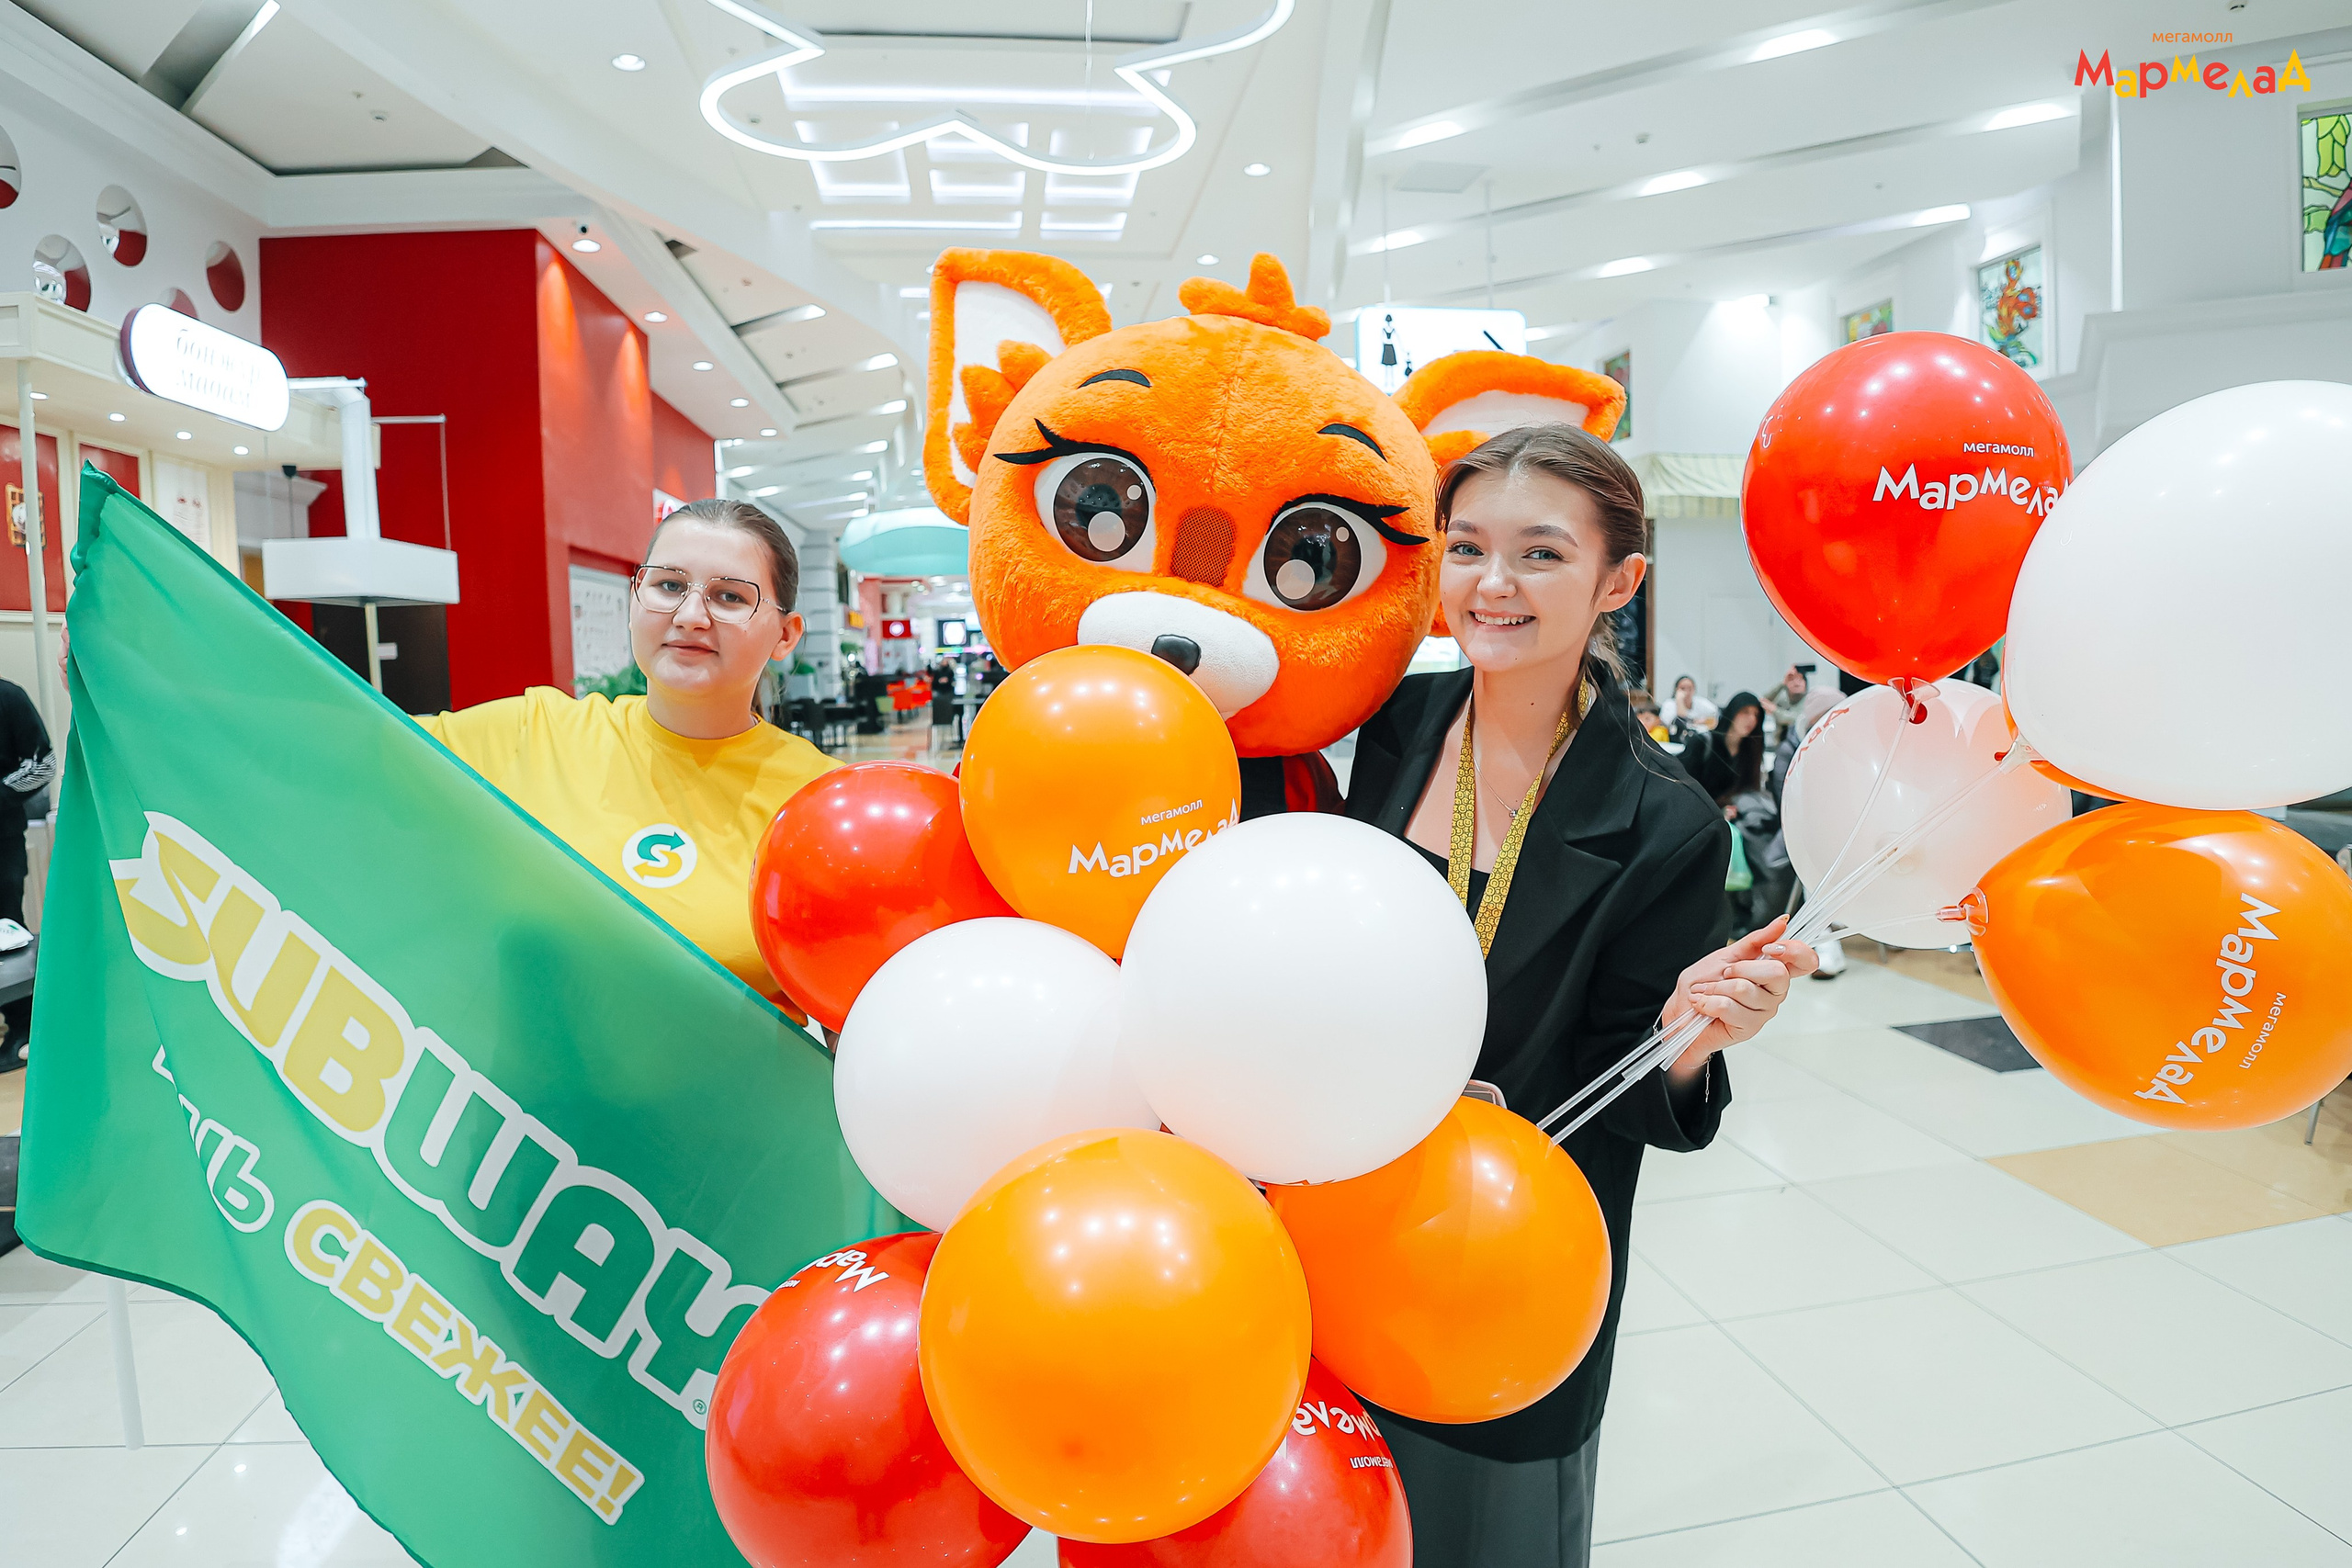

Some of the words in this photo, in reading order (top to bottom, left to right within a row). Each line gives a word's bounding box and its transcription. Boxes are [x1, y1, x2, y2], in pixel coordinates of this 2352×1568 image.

[1962, 441, 2034, 457] мегамолл
[1872, 462, 2070, 517] Мармела
[1140, 799, 1204, 826] мегамолл
[2238, 992, 2287, 1069] мегамолл
[108, 810, 772, 1419] SUBWAY
[284, 1200, 644, 1525] СВЕЖЕЕ!
